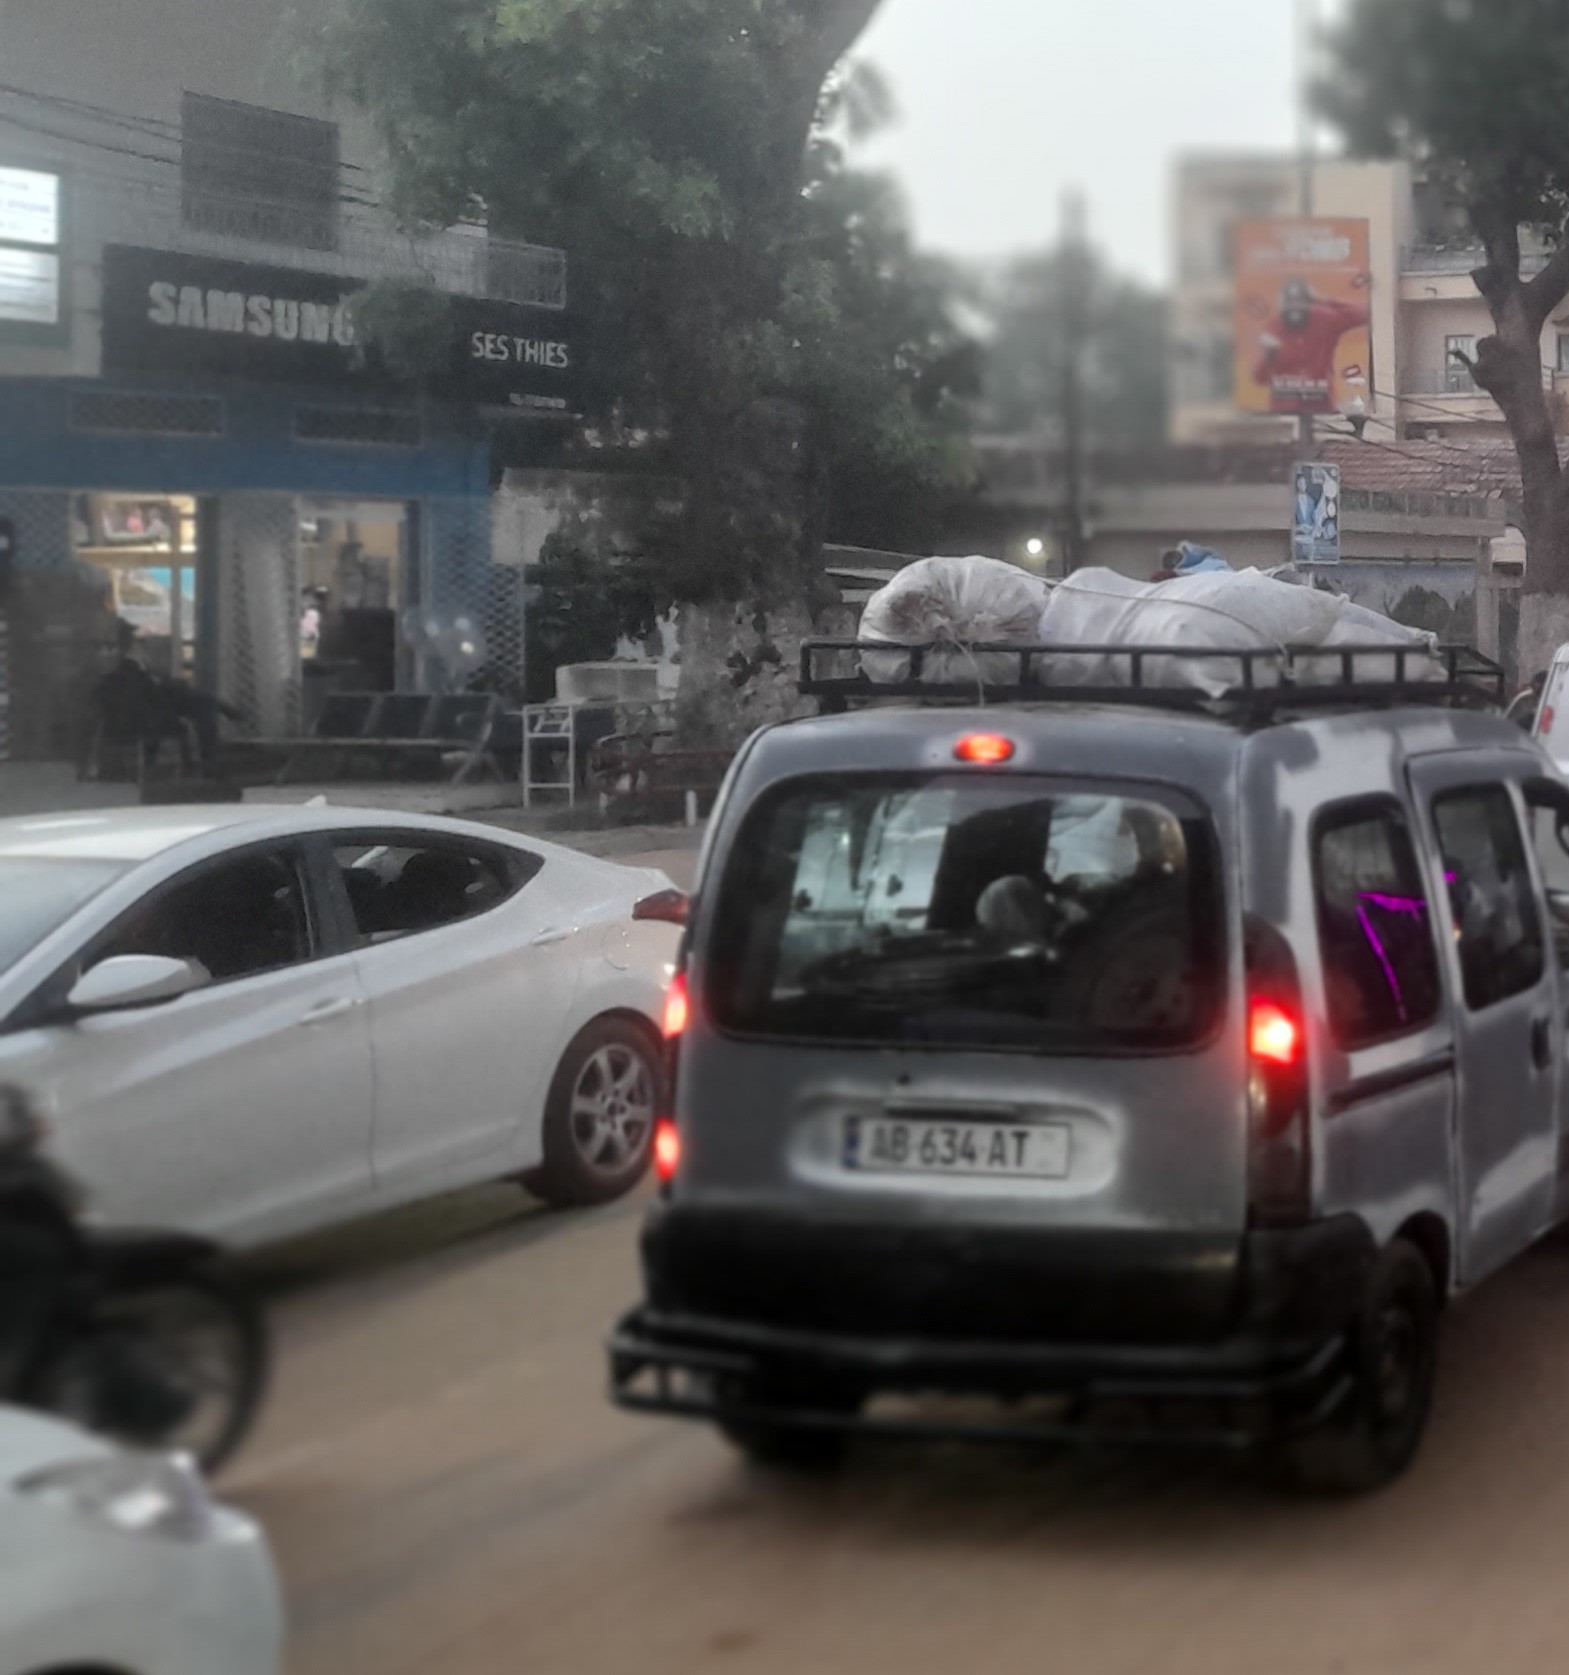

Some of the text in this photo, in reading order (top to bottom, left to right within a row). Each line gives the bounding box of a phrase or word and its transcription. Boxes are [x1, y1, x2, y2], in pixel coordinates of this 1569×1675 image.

[148, 281, 355, 346] SAMSUNG
[472, 331, 569, 369] SES THIES
